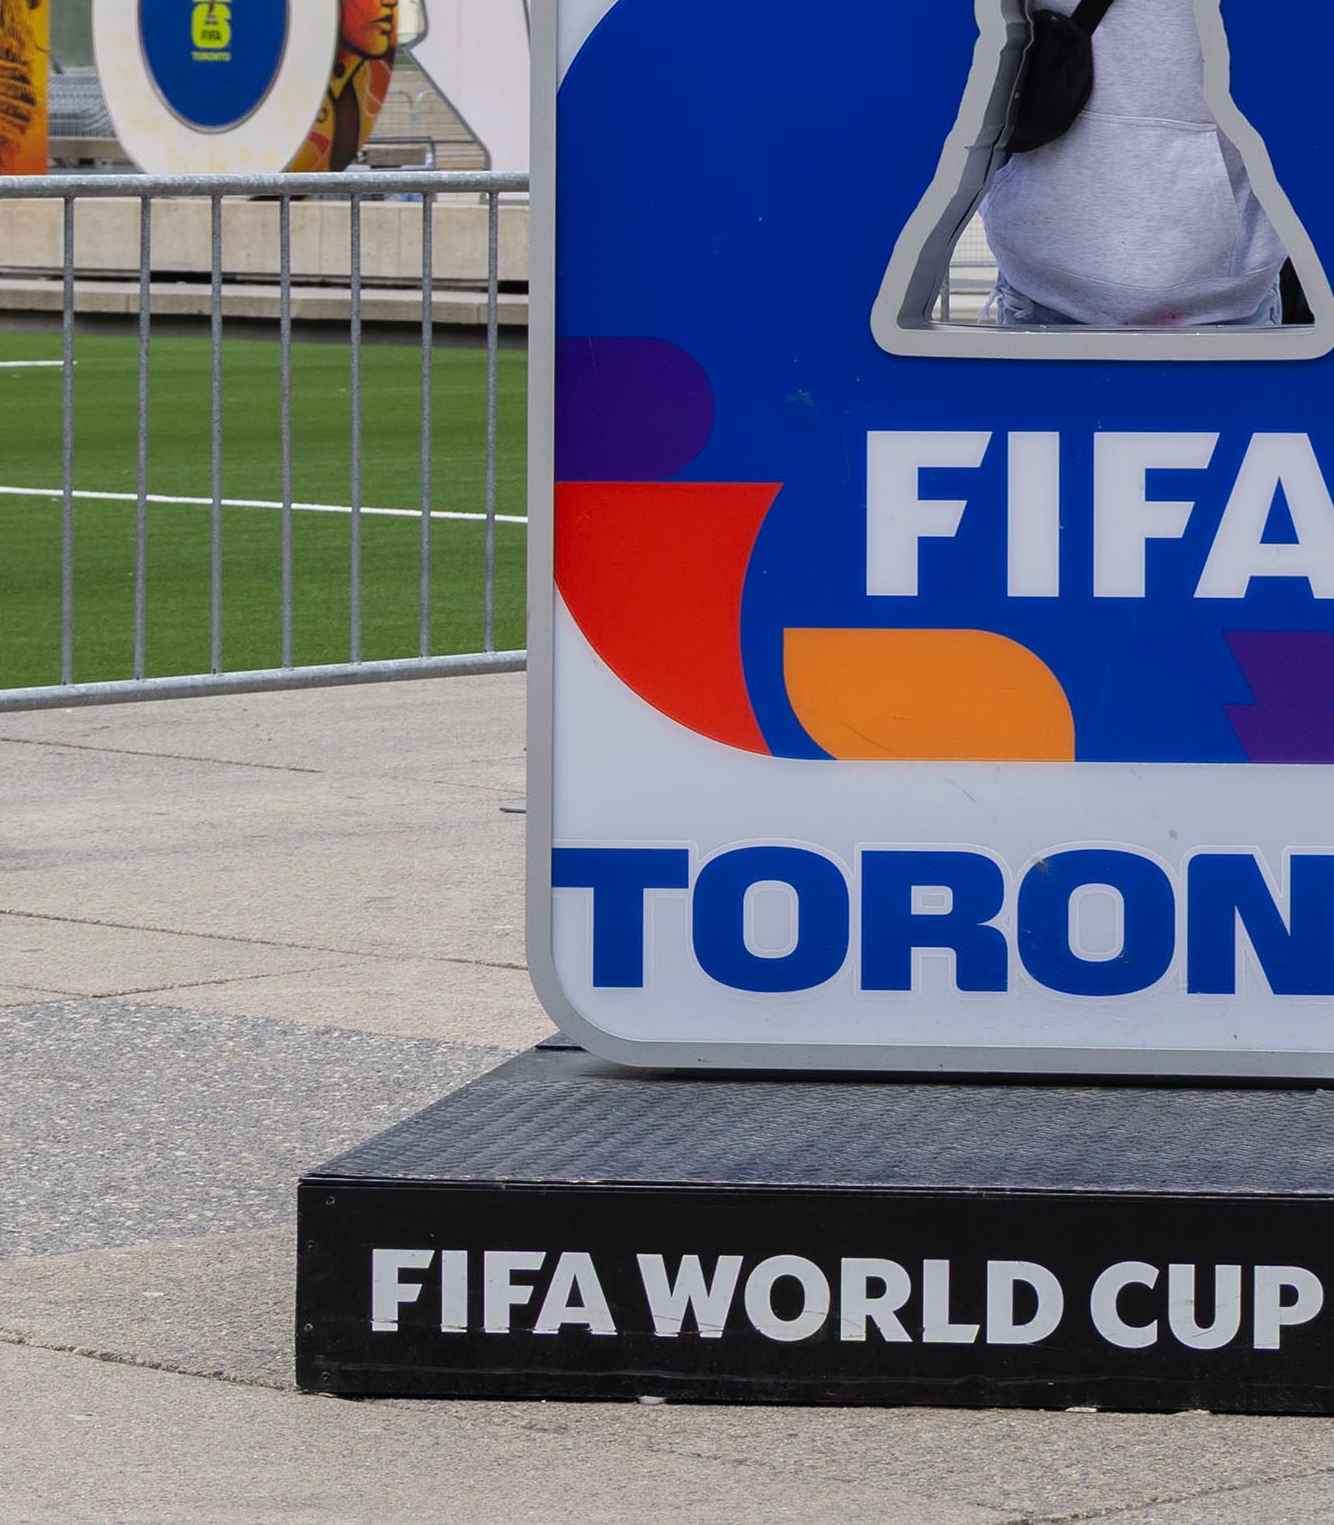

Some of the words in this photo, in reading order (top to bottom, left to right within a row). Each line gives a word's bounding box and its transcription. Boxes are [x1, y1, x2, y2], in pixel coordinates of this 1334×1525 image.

[370, 1248, 618, 1336] FIFA
[636, 1253, 1064, 1345] WORLD
[1090, 1260, 1324, 1350] CUP
